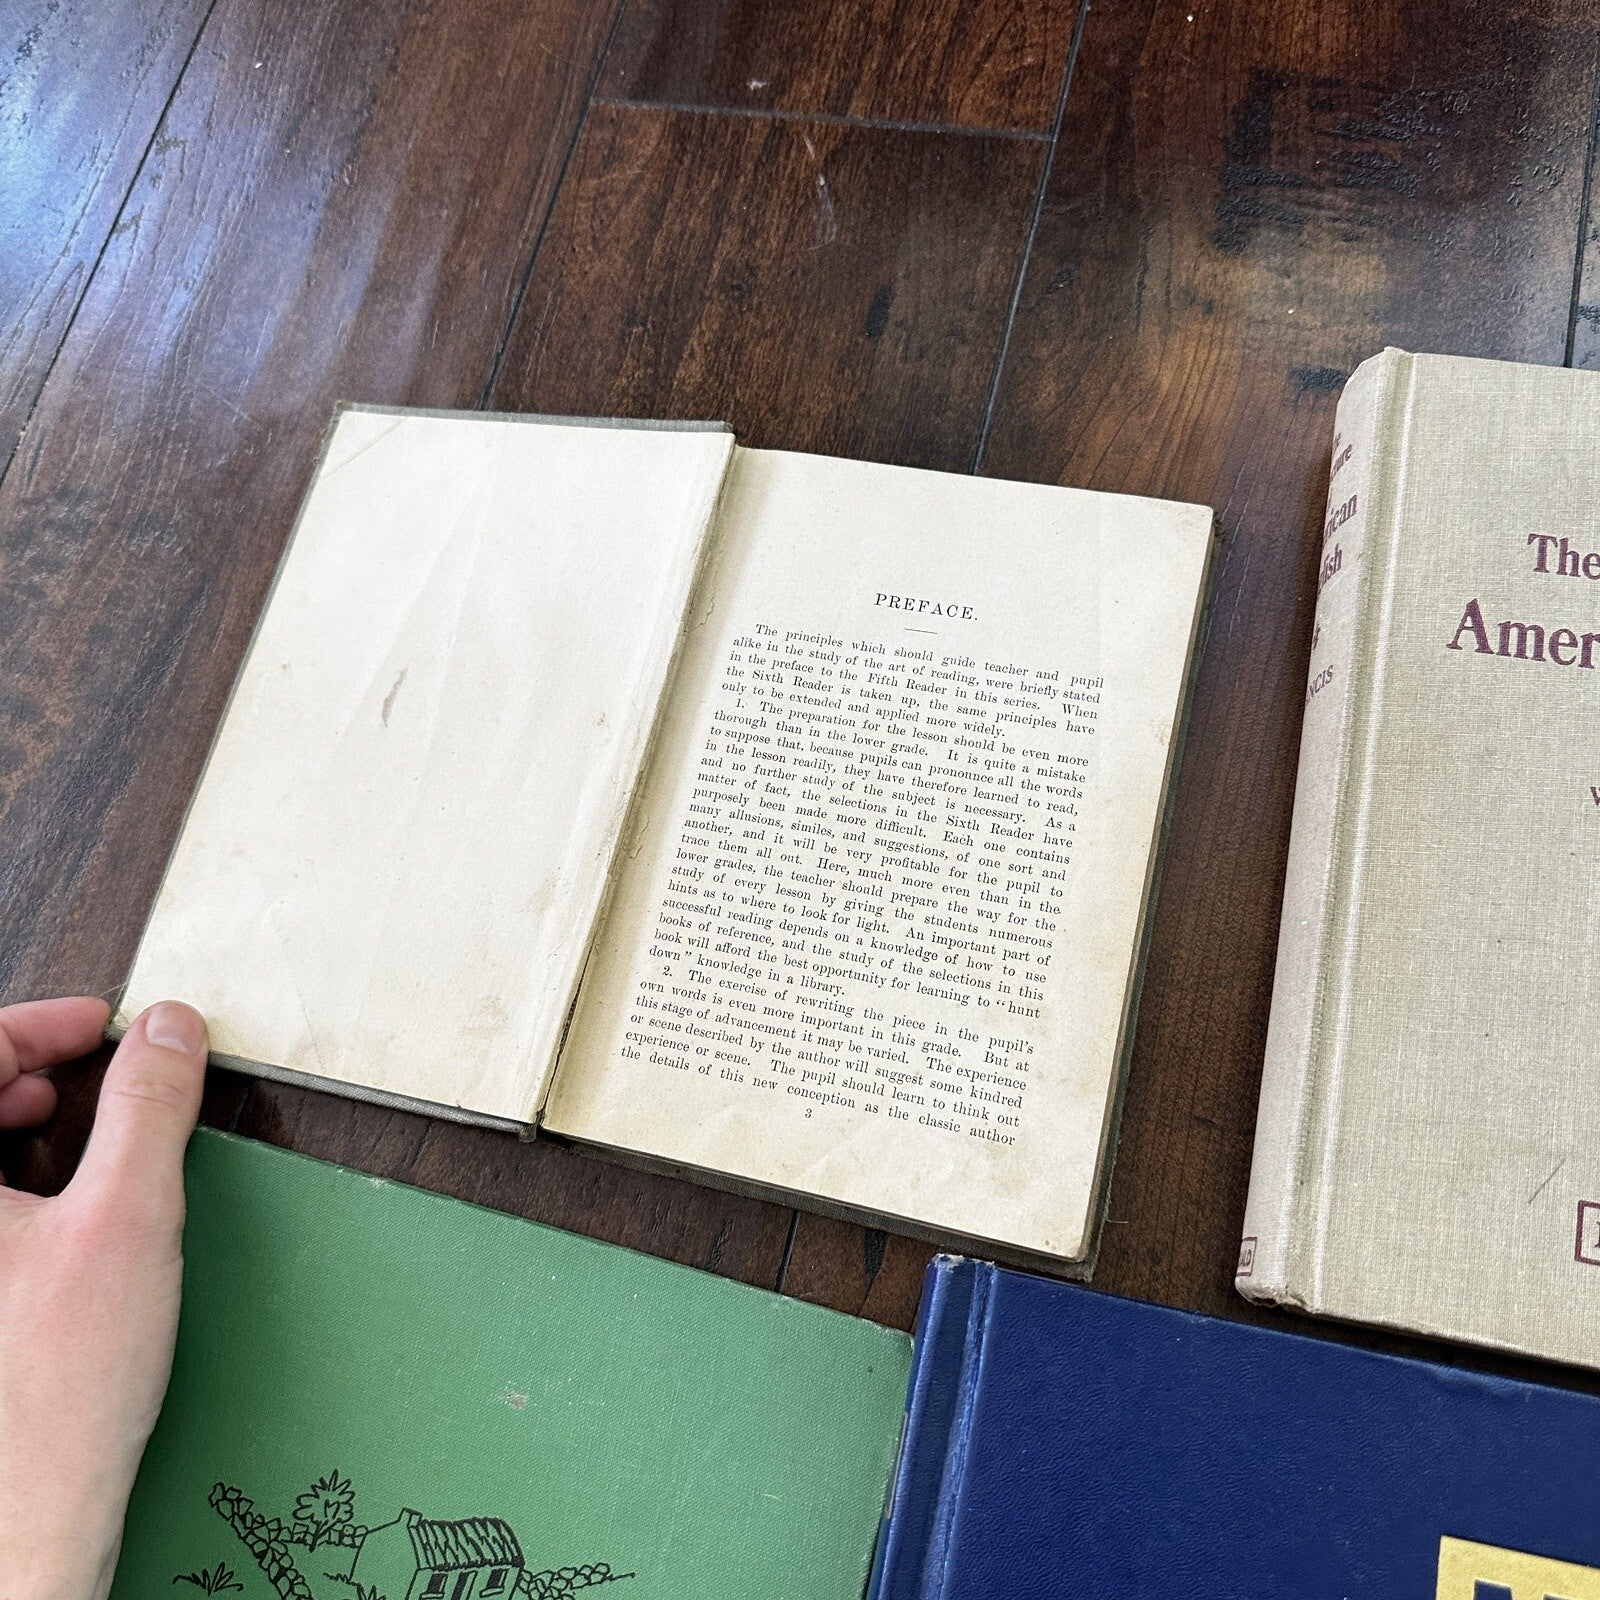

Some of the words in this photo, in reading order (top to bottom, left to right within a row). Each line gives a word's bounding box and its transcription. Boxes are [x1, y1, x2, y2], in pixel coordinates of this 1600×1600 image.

[1526, 533, 1600, 580] The
[874, 592, 978, 621] PREFACE.
[729, 649, 742, 663] in
[747, 652, 767, 666] the
[770, 658, 815, 674] preface
[820, 666, 834, 678] to
[838, 668, 859, 682] the
[866, 671, 899, 688] Fifth
[904, 677, 949, 696] Reader
[954, 685, 968, 700] in
[973, 689, 999, 705] this
[1002, 696, 1041, 711] series.
[1060, 702, 1099, 720] When
[754, 622, 779, 637] The
[784, 629, 844, 649] principles
[851, 639, 887, 656] which
[893, 646, 935, 663] should
[940, 655, 977, 669] guide
[983, 661, 1030, 677] teacher
[1034, 669, 1060, 683] and
[1068, 675, 1105, 691] pupil
[720, 681, 748, 696] only
[752, 685, 766, 697] to
[769, 686, 785, 701] be
[788, 693, 843, 710] extended
[846, 702, 871, 715] and
[874, 707, 921, 723] applied
[925, 715, 958, 729] more
[962, 720, 1006, 740] widely.
[725, 664, 746, 678] the
[751, 669, 784, 685] Sixth
[791, 674, 835, 693] Reader
[840, 683, 852, 696] is
[858, 686, 893, 703] taken
[900, 695, 921, 710] up,
[928, 697, 949, 712] the
[955, 705, 988, 719] same
[993, 710, 1058, 730] principles
[1065, 718, 1096, 736] have
[704, 738, 718, 752] in
[725, 742, 746, 757] the
[750, 746, 787, 765] lesson
[791, 757, 837, 775] readily,
[843, 763, 872, 782] they
[876, 768, 906, 786] have
[910, 775, 968, 797] therefore
[972, 785, 1020, 806] learned
[1026, 796, 1041, 809] to
[1045, 801, 1079, 818] read,
[713, 709, 768, 731] thorough
[775, 719, 803, 736] than
[807, 725, 821, 739] in
[826, 728, 847, 742] the
[851, 732, 887, 749] lower
[889, 742, 929, 757] grade.
[946, 748, 960, 762] It
[966, 751, 979, 766] is
[983, 757, 1017, 772] quite
[1021, 764, 1030, 775] a
[1035, 765, 1087, 784] mistake
[691, 787, 751, 809] purposely
[758, 795, 786, 813] been
[794, 805, 829, 820] made
[835, 812, 868, 828] more
[874, 817, 927, 839] difficult.
[941, 829, 975, 848] Each
[982, 841, 1007, 854] one
[1015, 847, 1071, 866] contains
[696, 771, 738, 787] matter
[743, 778, 759, 791] of
[763, 781, 792, 799] fact,
[801, 788, 822, 803] the
[828, 794, 888, 815] selections
[894, 804, 909, 819] in
[916, 808, 938, 824] the
[944, 813, 981, 832] Sixth
[989, 821, 1036, 842] Reader
[1042, 831, 1074, 849] have
[675, 846, 710, 864] lower
[712, 857, 757, 876] grades,
[763, 863, 784, 879] the
[790, 869, 837, 889] teacher
[841, 878, 884, 899] should
[889, 890, 940, 909] prepare
[946, 899, 969, 916] the
[975, 907, 1002, 924] way
[1006, 911, 1029, 927] for
[1034, 916, 1057, 933] the
[683, 818, 734, 838] another,
[741, 829, 767, 842] and
[773, 831, 785, 845] it
[792, 837, 816, 851] will
[822, 840, 838, 856] be
[845, 848, 874, 865] very
[879, 854, 941, 875] profitable
[947, 865, 969, 880] for
[976, 870, 999, 887] the
[1004, 879, 1042, 896] pupil
[1049, 884, 1064, 899] to
[661, 898, 723, 918] successful
[726, 910, 775, 931] reading
[778, 917, 830, 940] depends
[833, 932, 850, 944] on
[855, 936, 864, 947] a
[869, 935, 940, 964] knowledge
[943, 952, 960, 966] of
[965, 954, 994, 972] how
[1002, 964, 1017, 978] to
[1024, 970, 1048, 985] use
[670, 865, 706, 883] study
[712, 872, 728, 885] of
[733, 878, 768, 896] every
[774, 882, 812, 902] lesson
[820, 891, 838, 909] by
[842, 897, 886, 919] giving
[893, 906, 916, 922] the
[923, 913, 980, 935] students
[987, 927, 1053, 950] numerous
[648, 944, 693, 962] down”
[695, 952, 763, 980] knowledge
[766, 967, 781, 983] in
[785, 975, 795, 986] a
[799, 974, 846, 998] library.
[620, 1044, 642, 1061] the
[648, 1050, 691, 1072] details
[697, 1063, 714, 1077] of
[719, 1066, 745, 1084] this
[751, 1076, 779, 1091] new
[786, 1084, 856, 1110] conception
[863, 1102, 880, 1115] as
[887, 1104, 910, 1122] the
[917, 1112, 962, 1134] classic
[968, 1126, 1017, 1147] author
[629, 1013, 645, 1025] or
[647, 1017, 683, 1033] scene
[684, 1021, 745, 1047] described
[749, 1035, 766, 1054] by
[771, 1041, 793, 1057] the
[796, 1049, 842, 1068] author
[844, 1058, 870, 1075] will
[873, 1066, 924, 1087] suggest
[928, 1079, 964, 1096] some
[968, 1084, 1023, 1110] kindred
[804, 1107, 813, 1119] 3
